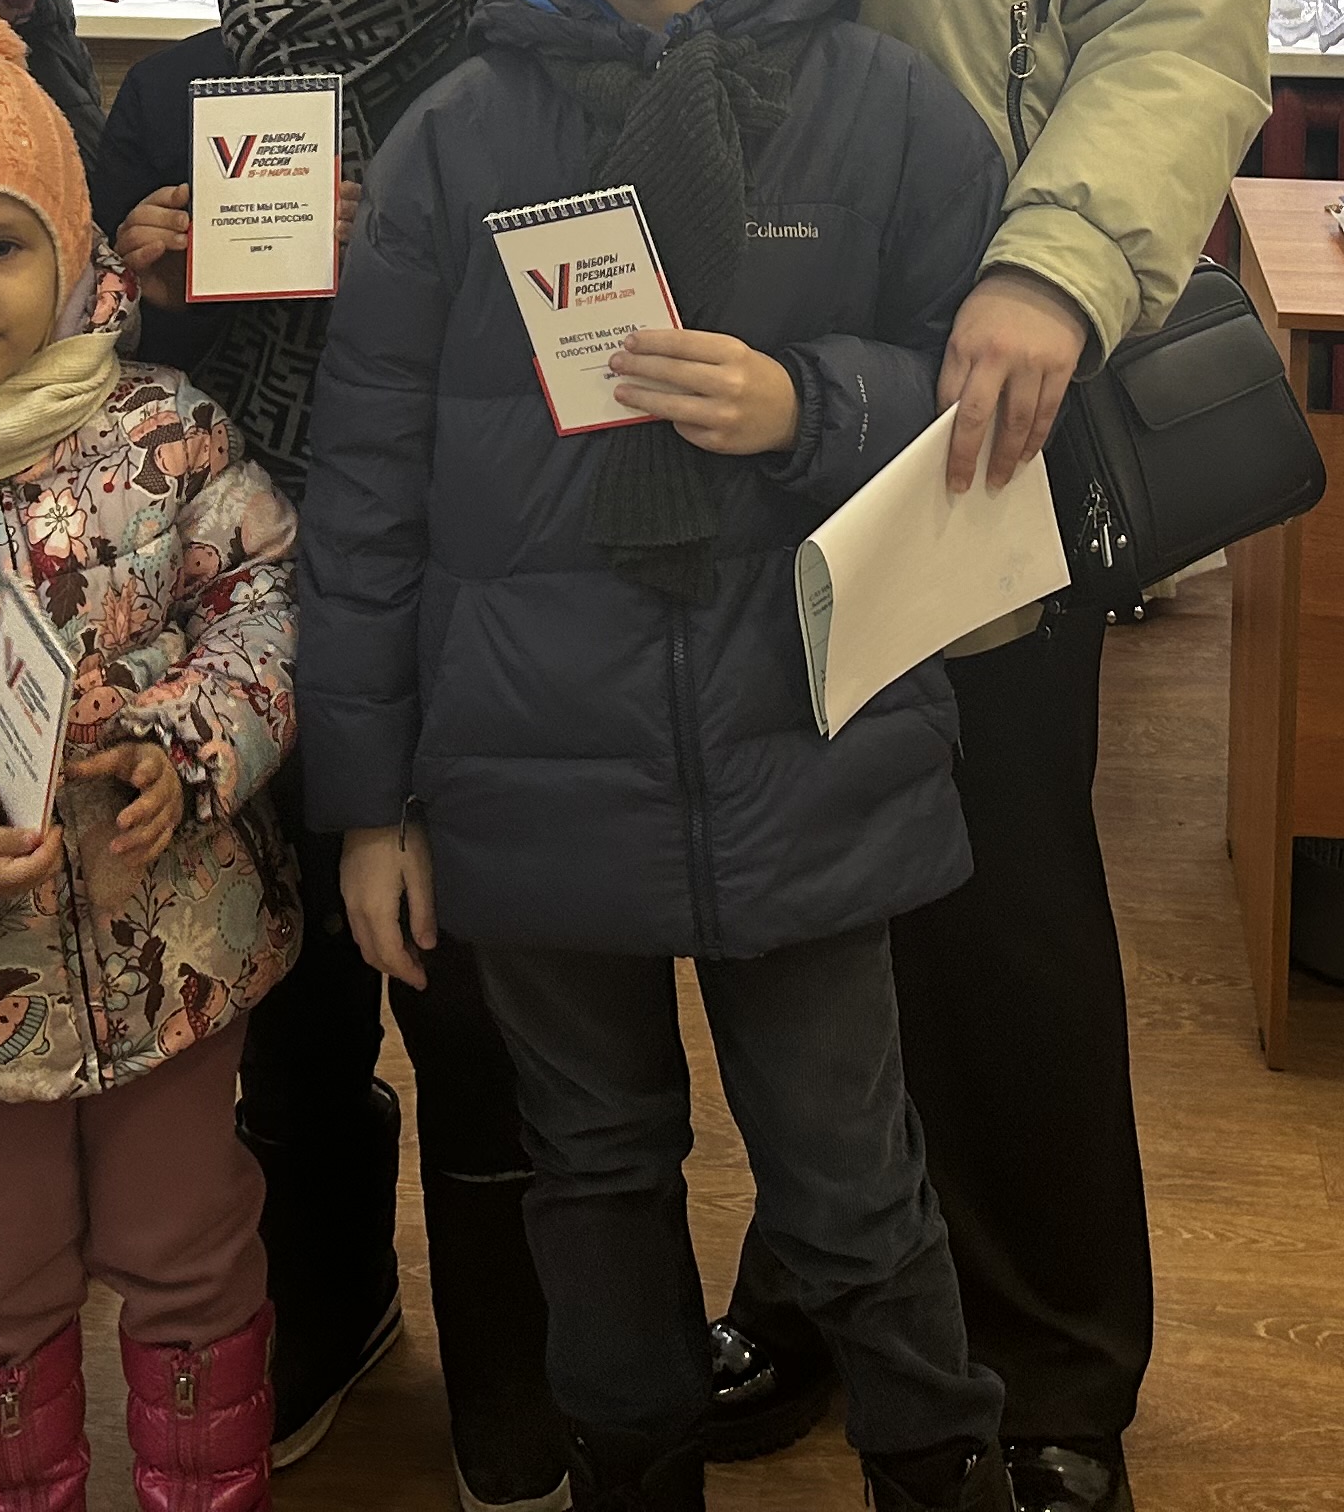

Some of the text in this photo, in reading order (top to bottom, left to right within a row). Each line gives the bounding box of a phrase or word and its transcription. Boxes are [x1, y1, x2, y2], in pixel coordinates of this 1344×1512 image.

[260, 131, 307, 144] ВЫБОРЫ
[256, 143, 319, 156] ПРЕЗИДЕНТА
[250, 156, 292, 168] РОССИИ
[219, 203, 256, 213] ВМЕСТЕ
[256, 202, 273, 211] МЫ
[274, 201, 299, 210] СИЛА
[211, 216, 259, 226] ГОЛОСУЕМ
[261, 215, 273, 224] ЗА
[744, 221, 819, 239] Columbia
[576, 252, 618, 271] ВЫБОРЫ
[575, 262, 636, 282] ПРЕЗИДЕНТА
[575, 279, 613, 296] РОССИИ
[558, 331, 595, 345] ВМЕСТЕ
[595, 328, 612, 338] МЫ
[612, 323, 638, 335] СИЛА
[555, 342, 604, 359] ГОЛОСУЕМ
[604, 341, 617, 351] ЗА
